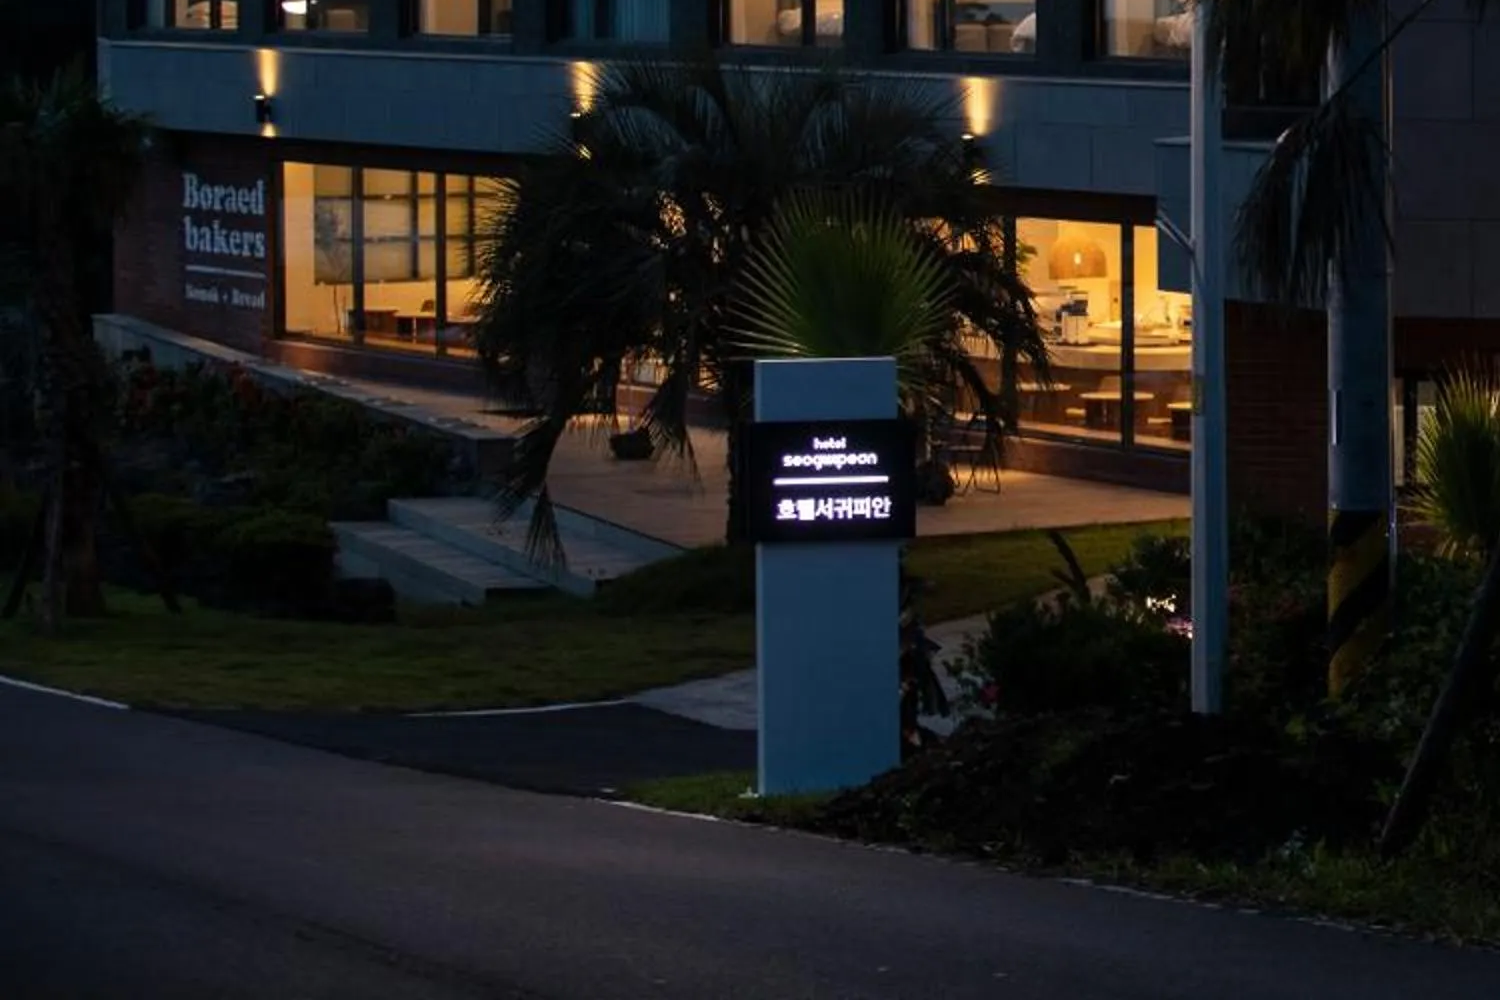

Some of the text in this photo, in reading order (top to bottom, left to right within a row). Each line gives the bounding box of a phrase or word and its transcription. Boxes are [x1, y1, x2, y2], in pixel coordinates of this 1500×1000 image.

[182, 173, 265, 215] Boraed
[184, 216, 266, 258] bakers
[813, 437, 846, 450] hotel
